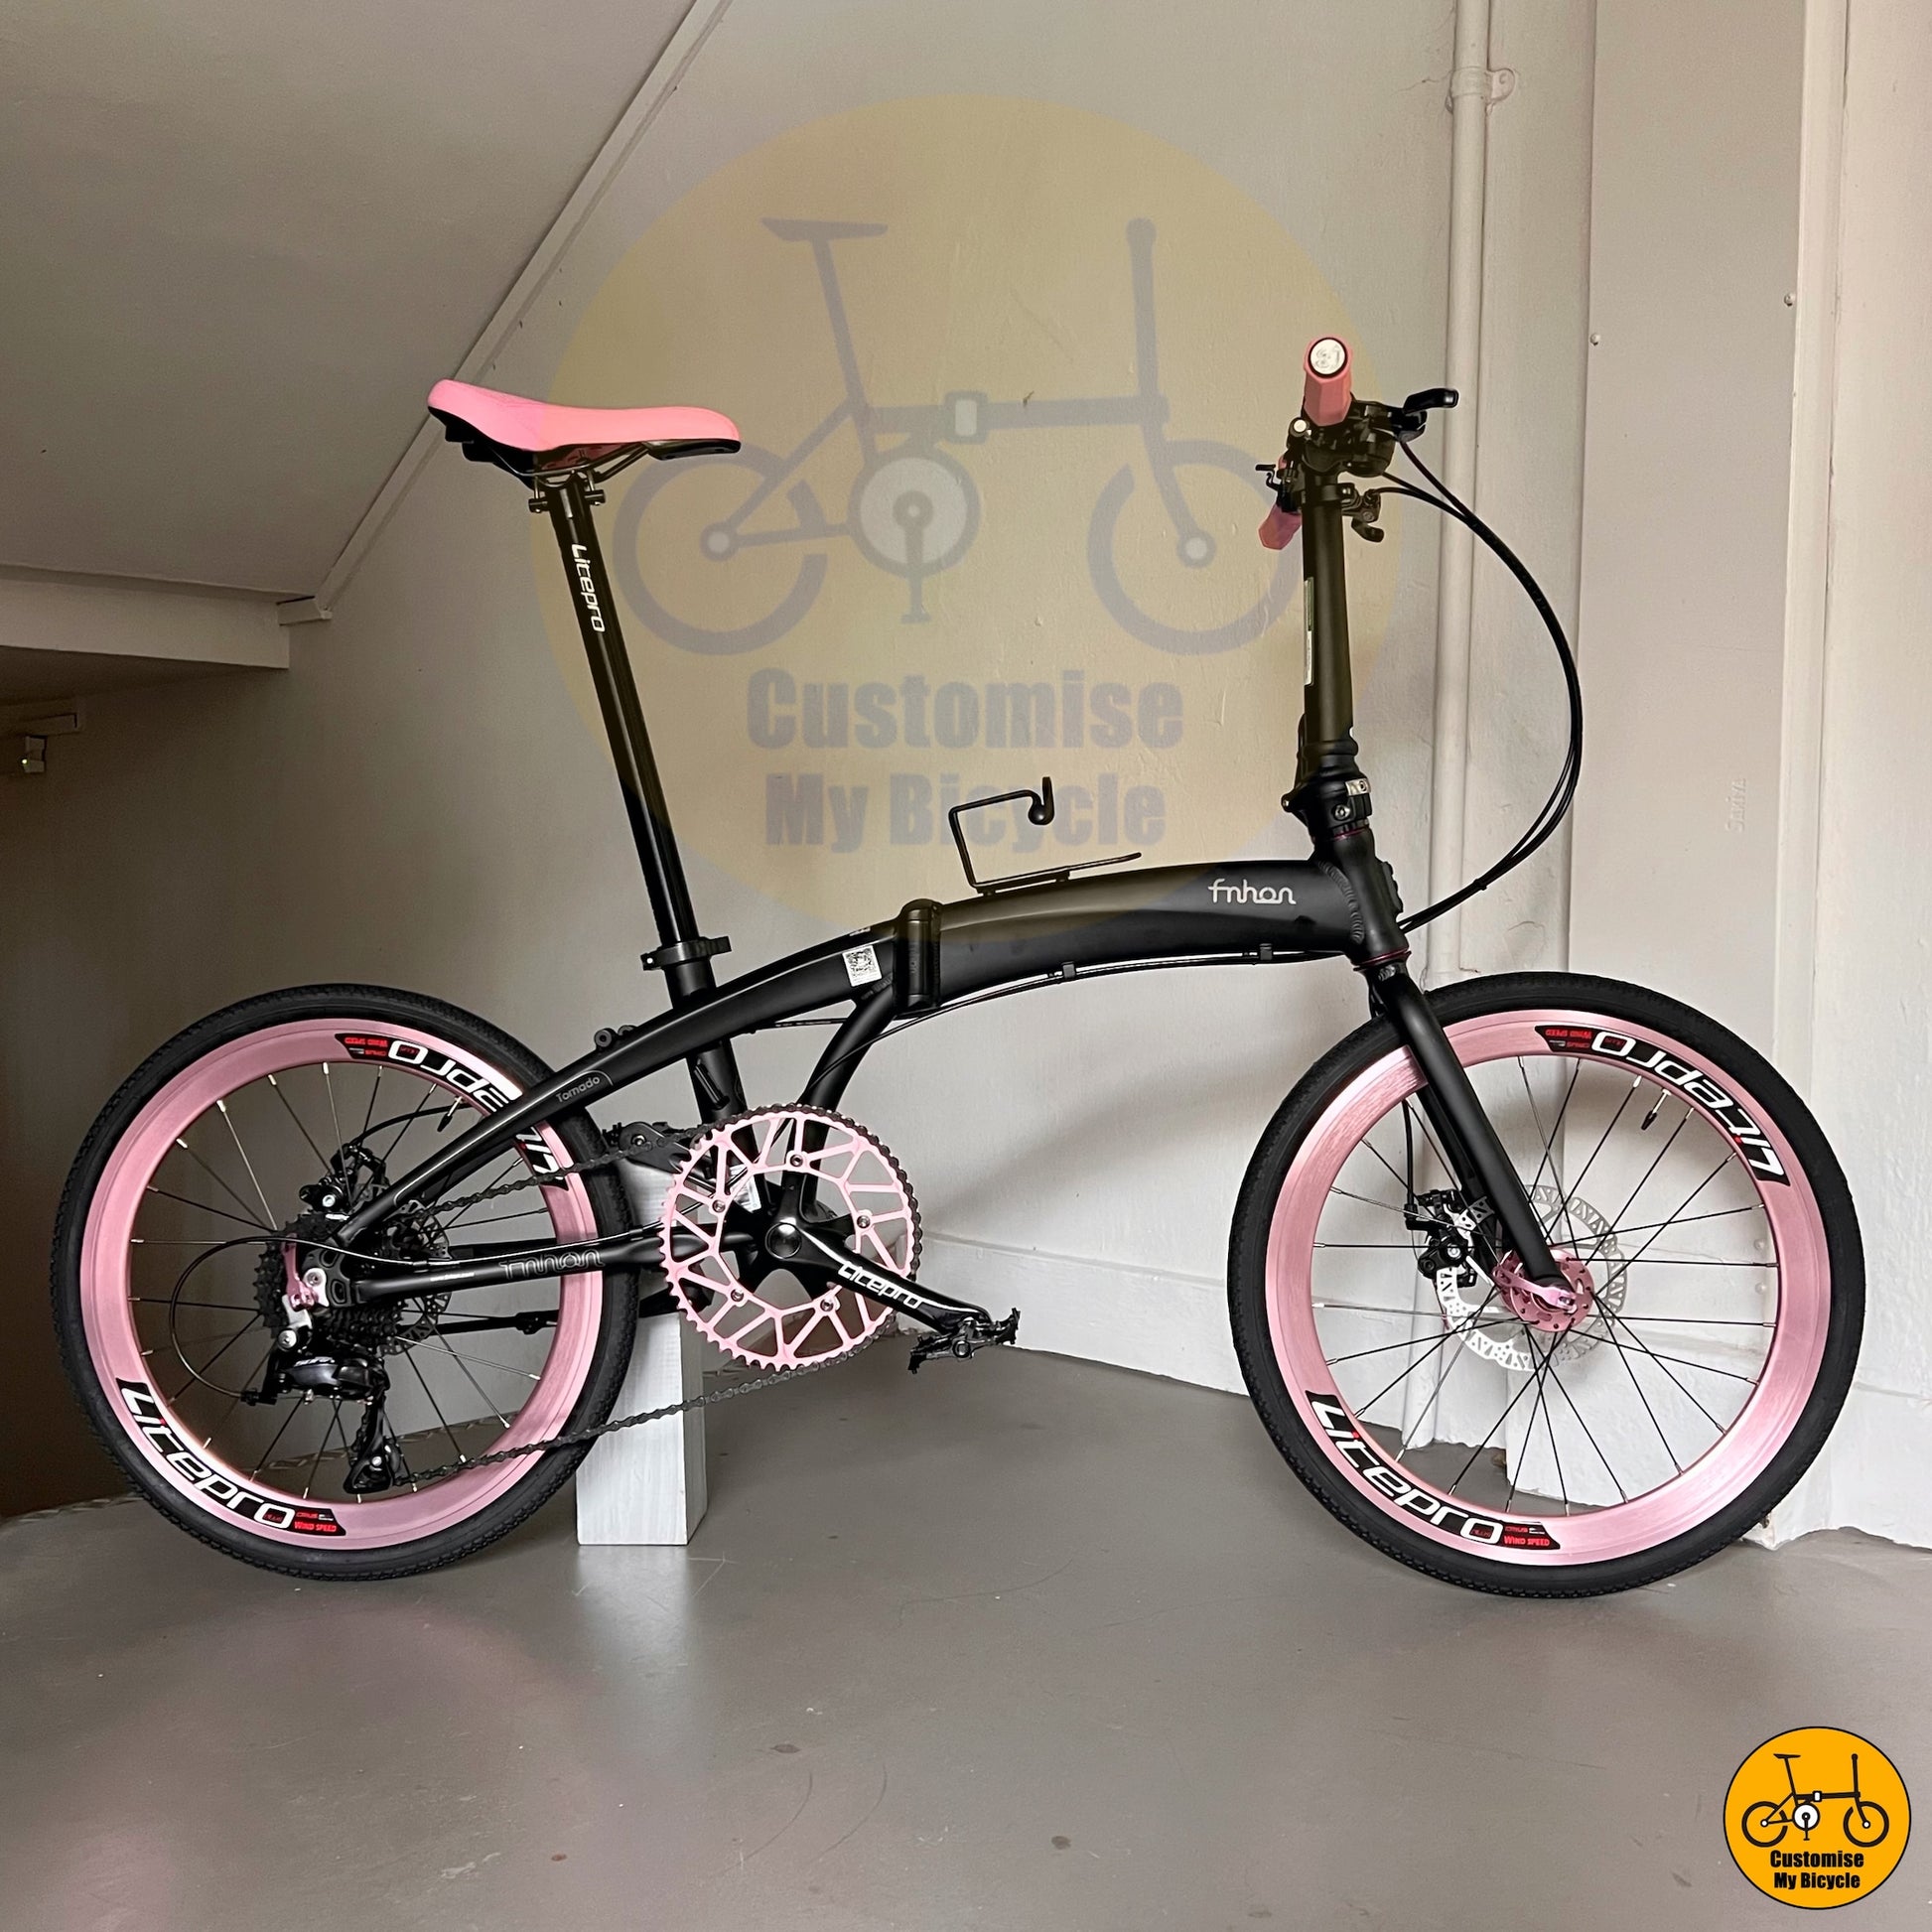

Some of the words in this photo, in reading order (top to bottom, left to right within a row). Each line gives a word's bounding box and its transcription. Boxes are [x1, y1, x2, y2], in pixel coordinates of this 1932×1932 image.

[1207, 878, 1297, 904] fnhon
[556, 1076, 601, 1103] Tornado
[121, 1388, 296, 1529] Litepro
[1311, 1401, 1503, 1545] Litepro
